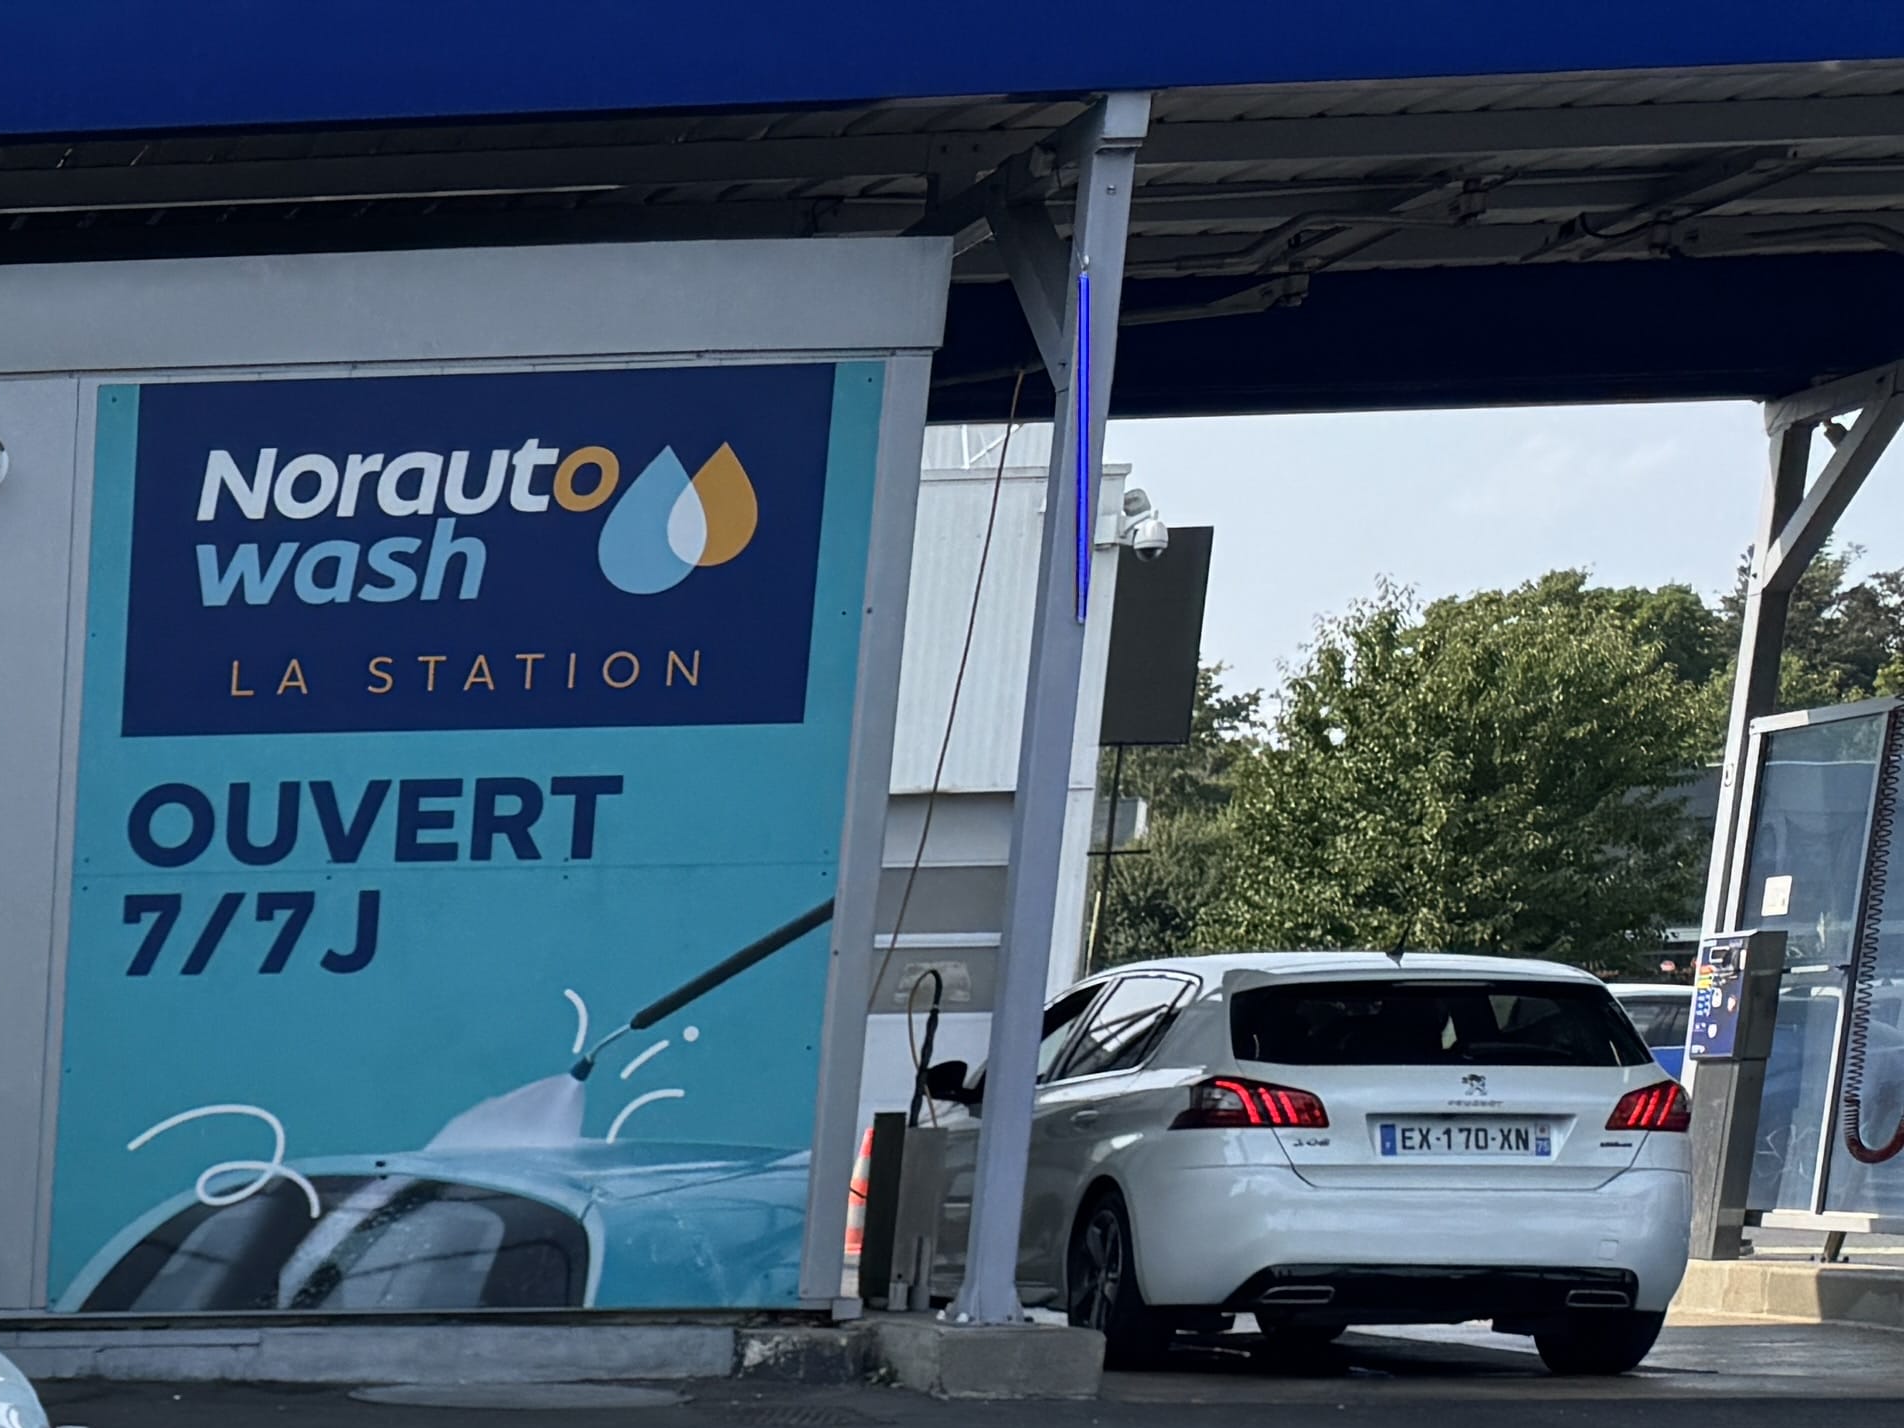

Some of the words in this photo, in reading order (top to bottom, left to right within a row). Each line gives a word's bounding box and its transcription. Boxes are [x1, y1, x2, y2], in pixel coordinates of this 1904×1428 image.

[196, 438, 620, 521] Norauto
[195, 517, 487, 607] wash
[230, 658, 309, 697] LA
[366, 649, 701, 693] STATION
[127, 774, 624, 868] OUVERT
[122, 889, 381, 977] 7/7J
[1400, 1126, 1531, 1152] EX-170-XN
